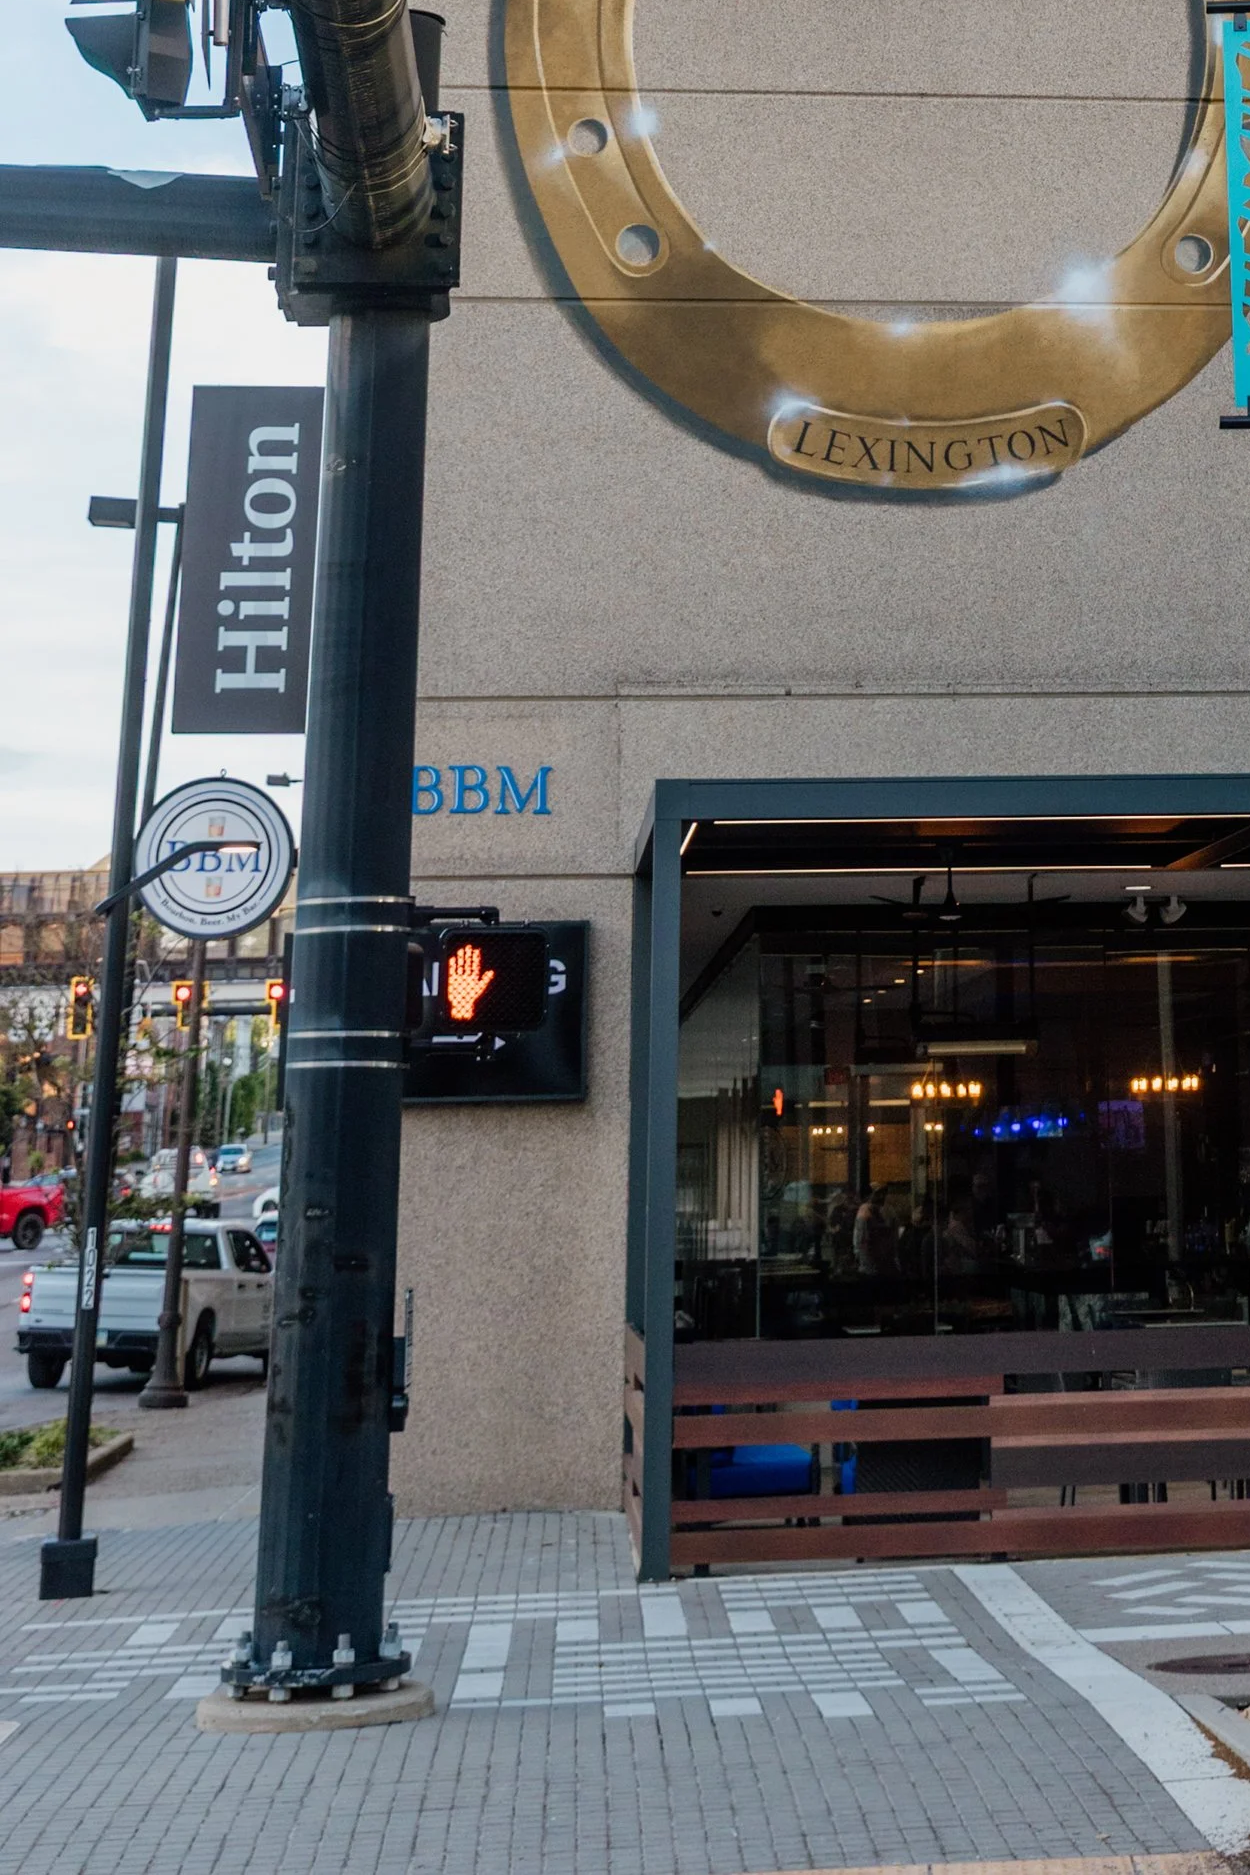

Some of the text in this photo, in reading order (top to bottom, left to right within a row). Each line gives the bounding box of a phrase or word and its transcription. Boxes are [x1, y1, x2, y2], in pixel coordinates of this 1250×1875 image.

[791, 418, 1071, 474] LEXINGTON
[214, 422, 300, 694] Hilton
[411, 765, 553, 815] BBM
[82, 1227, 98, 1308] 1022
